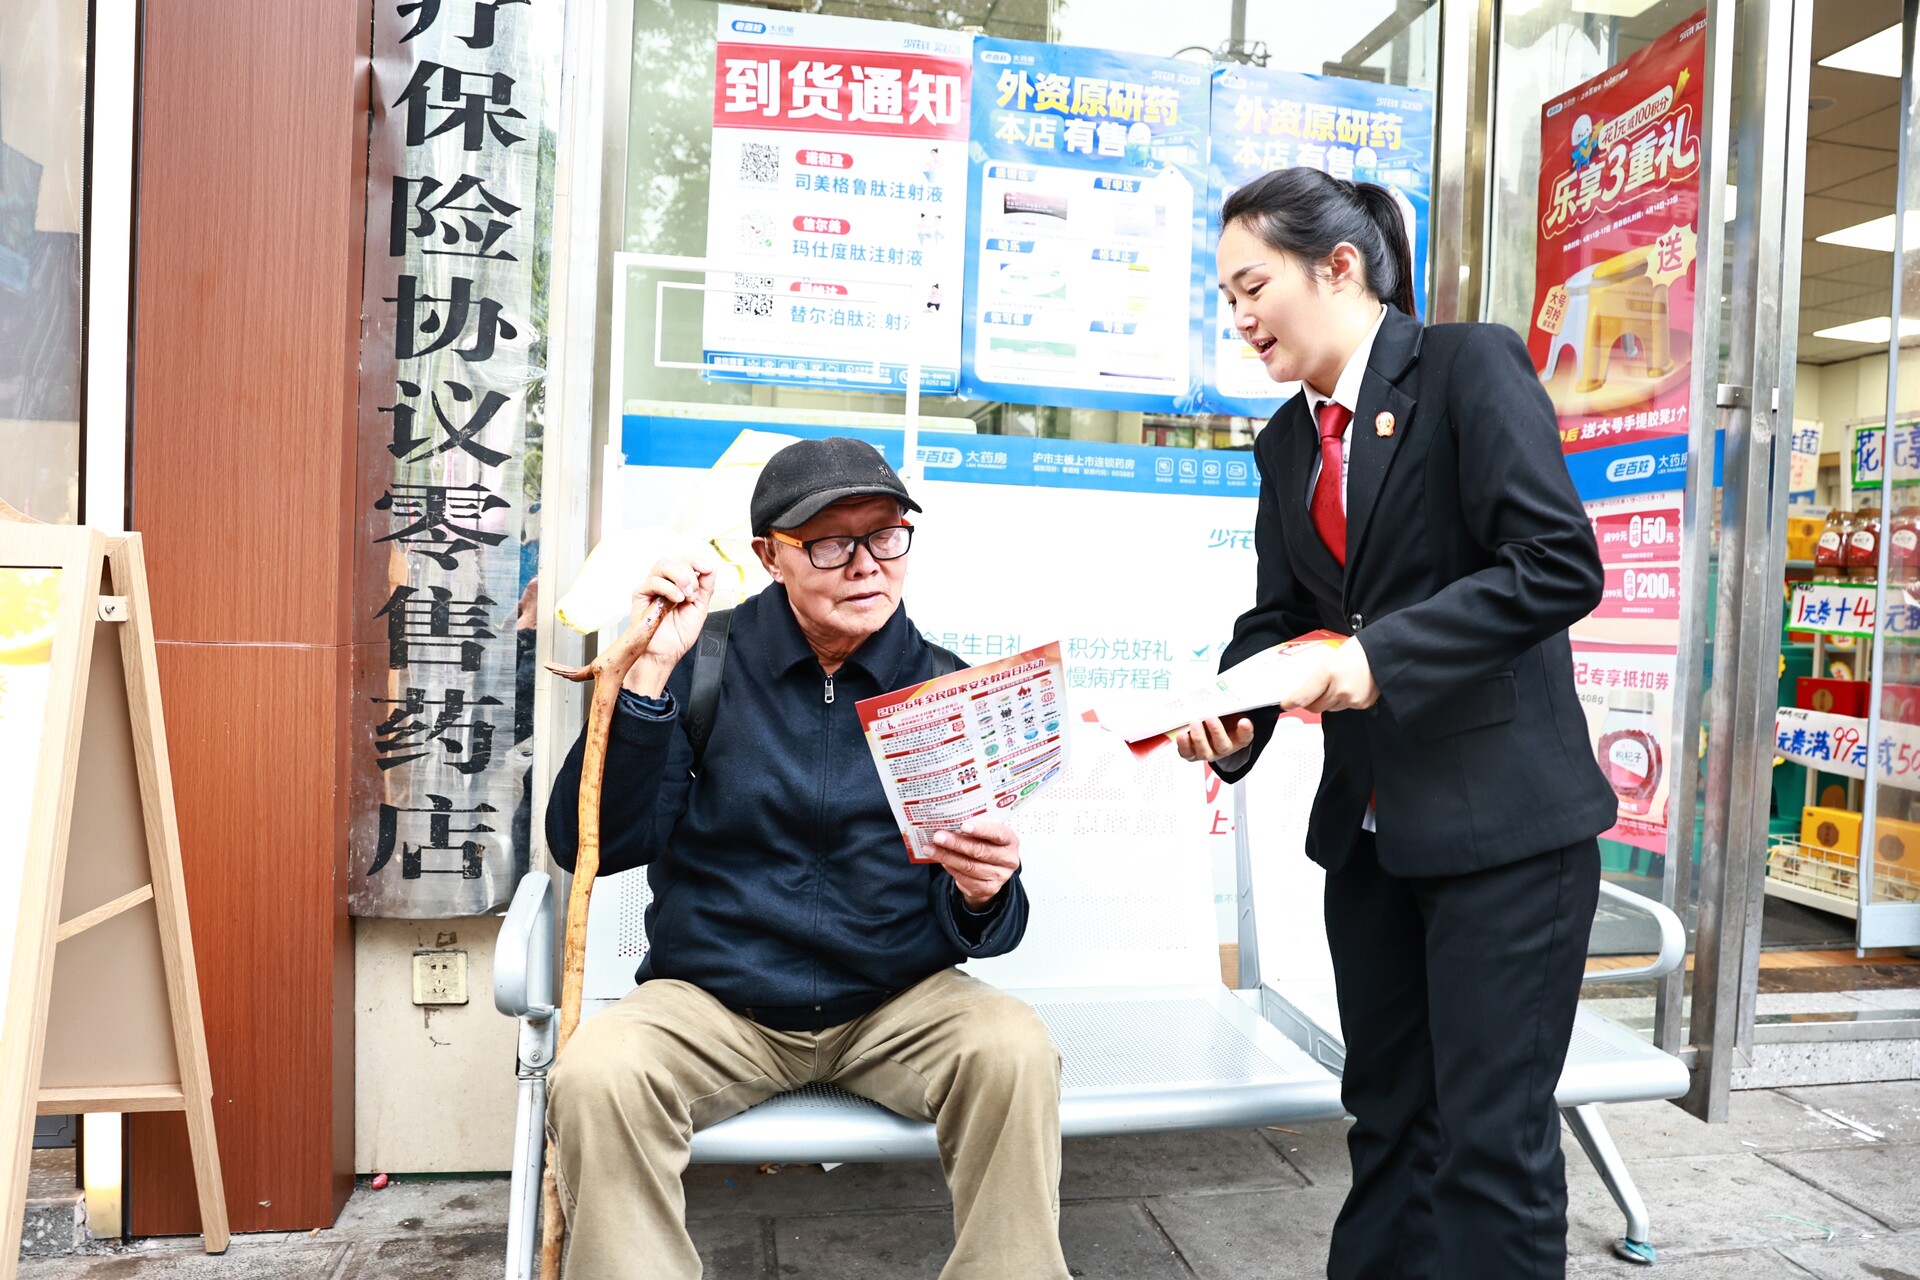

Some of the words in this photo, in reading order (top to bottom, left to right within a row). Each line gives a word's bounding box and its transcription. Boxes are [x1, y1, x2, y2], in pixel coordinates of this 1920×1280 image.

[724, 58, 962, 126] 到货通知
[996, 68, 1180, 126] 外资原研药
[994, 113, 1057, 149] 本店
[1064, 118, 1128, 157] 有售
[1234, 94, 1403, 150] 外资原研药
[1602, 95, 1670, 145] 花1元或100积分
[795, 172, 943, 203] 司美格鲁肽注射液
[1546, 113, 1695, 228] 乐享3重礼
[793, 239, 922, 267] 玛仕度肽注射液
[1657, 233, 1682, 274] 送
[1580, 404, 1687, 440] 送大号手提胶凳1个
[966, 451, 1007, 464] 大药房
[1033, 452, 1135, 470] 沪市主板上市连锁药房
[1066, 637, 1173, 662] 积分兑好礼
[878, 659, 1044, 717] 2026年全民国家安全教育日活动
[1066, 666, 1172, 690] 慢病疗程省
